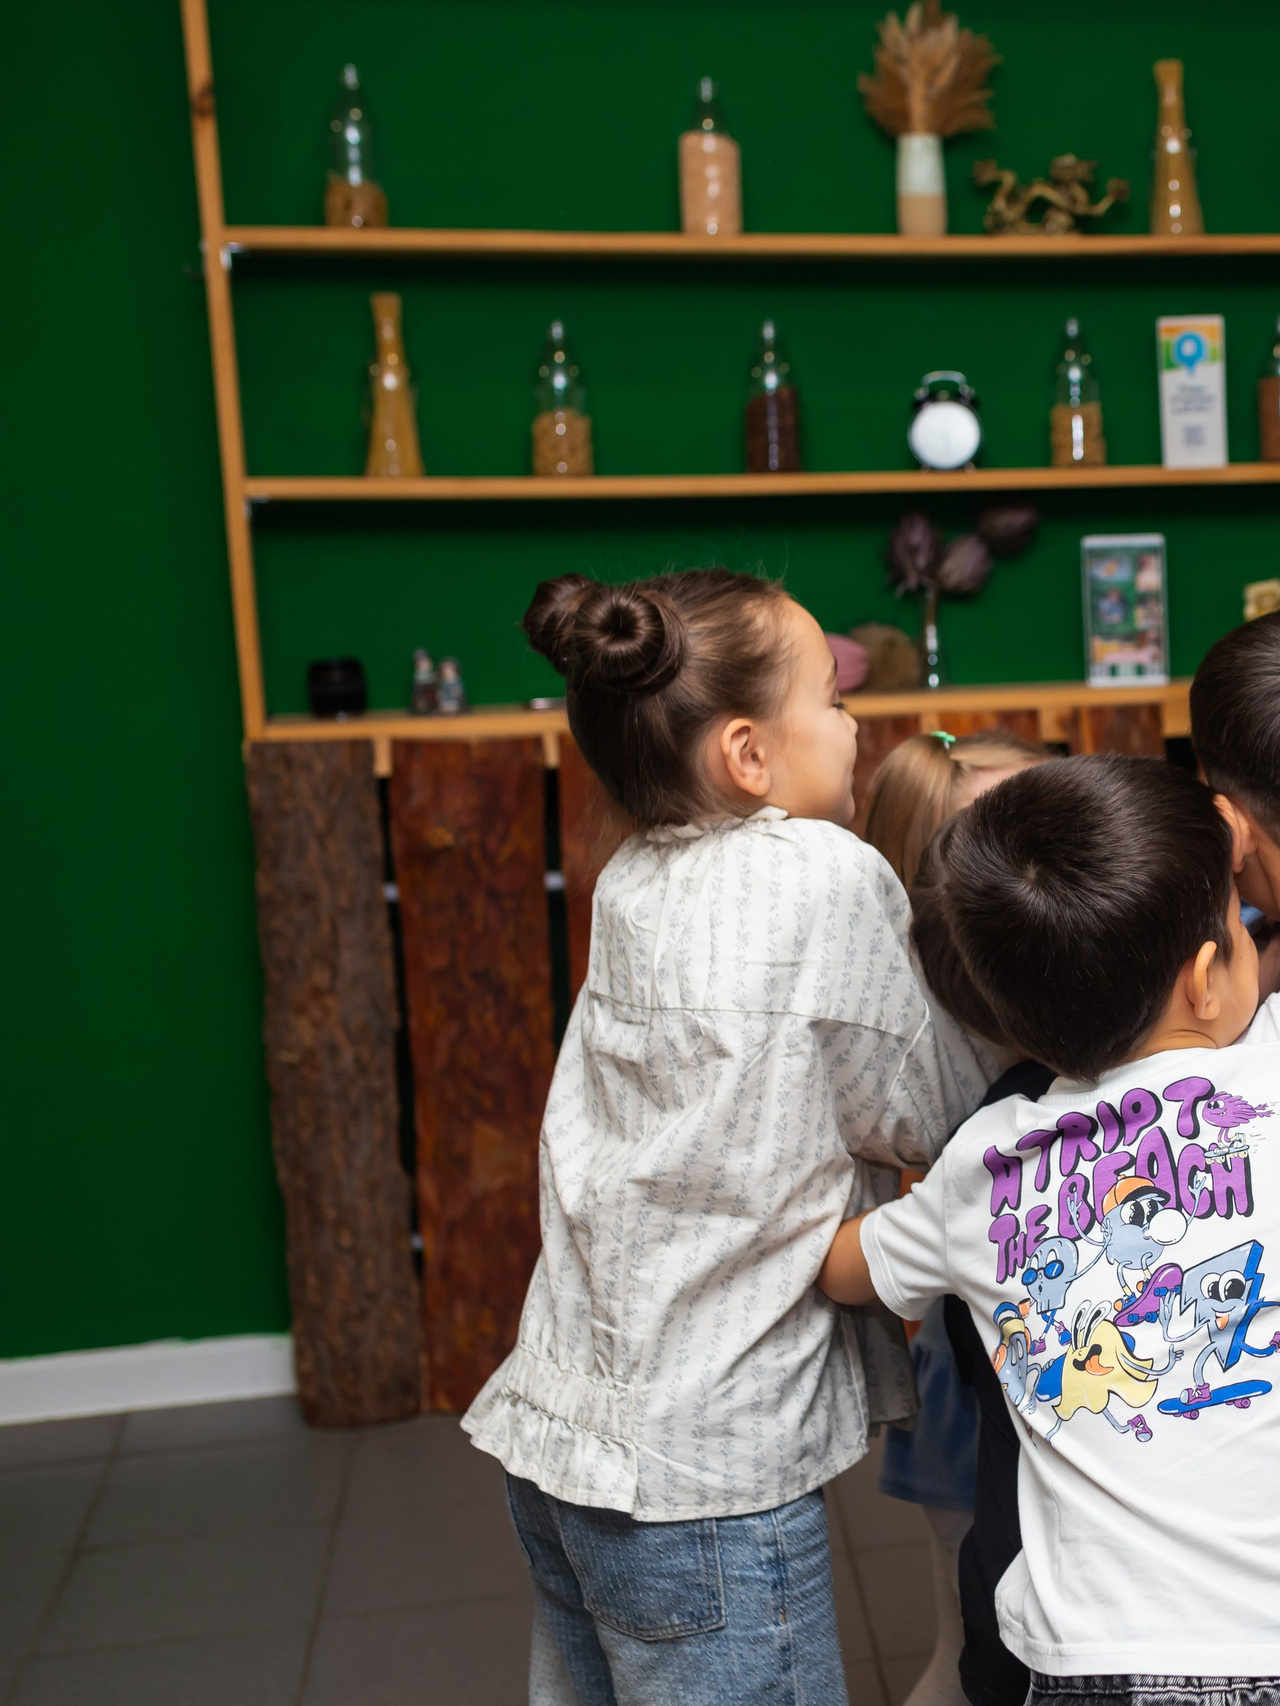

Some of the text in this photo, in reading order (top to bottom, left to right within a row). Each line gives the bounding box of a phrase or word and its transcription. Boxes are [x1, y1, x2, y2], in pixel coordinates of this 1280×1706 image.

[983, 1145, 1023, 1217] A
[1016, 1088, 1163, 1192] TRIP
[988, 1204, 1052, 1284] THE
